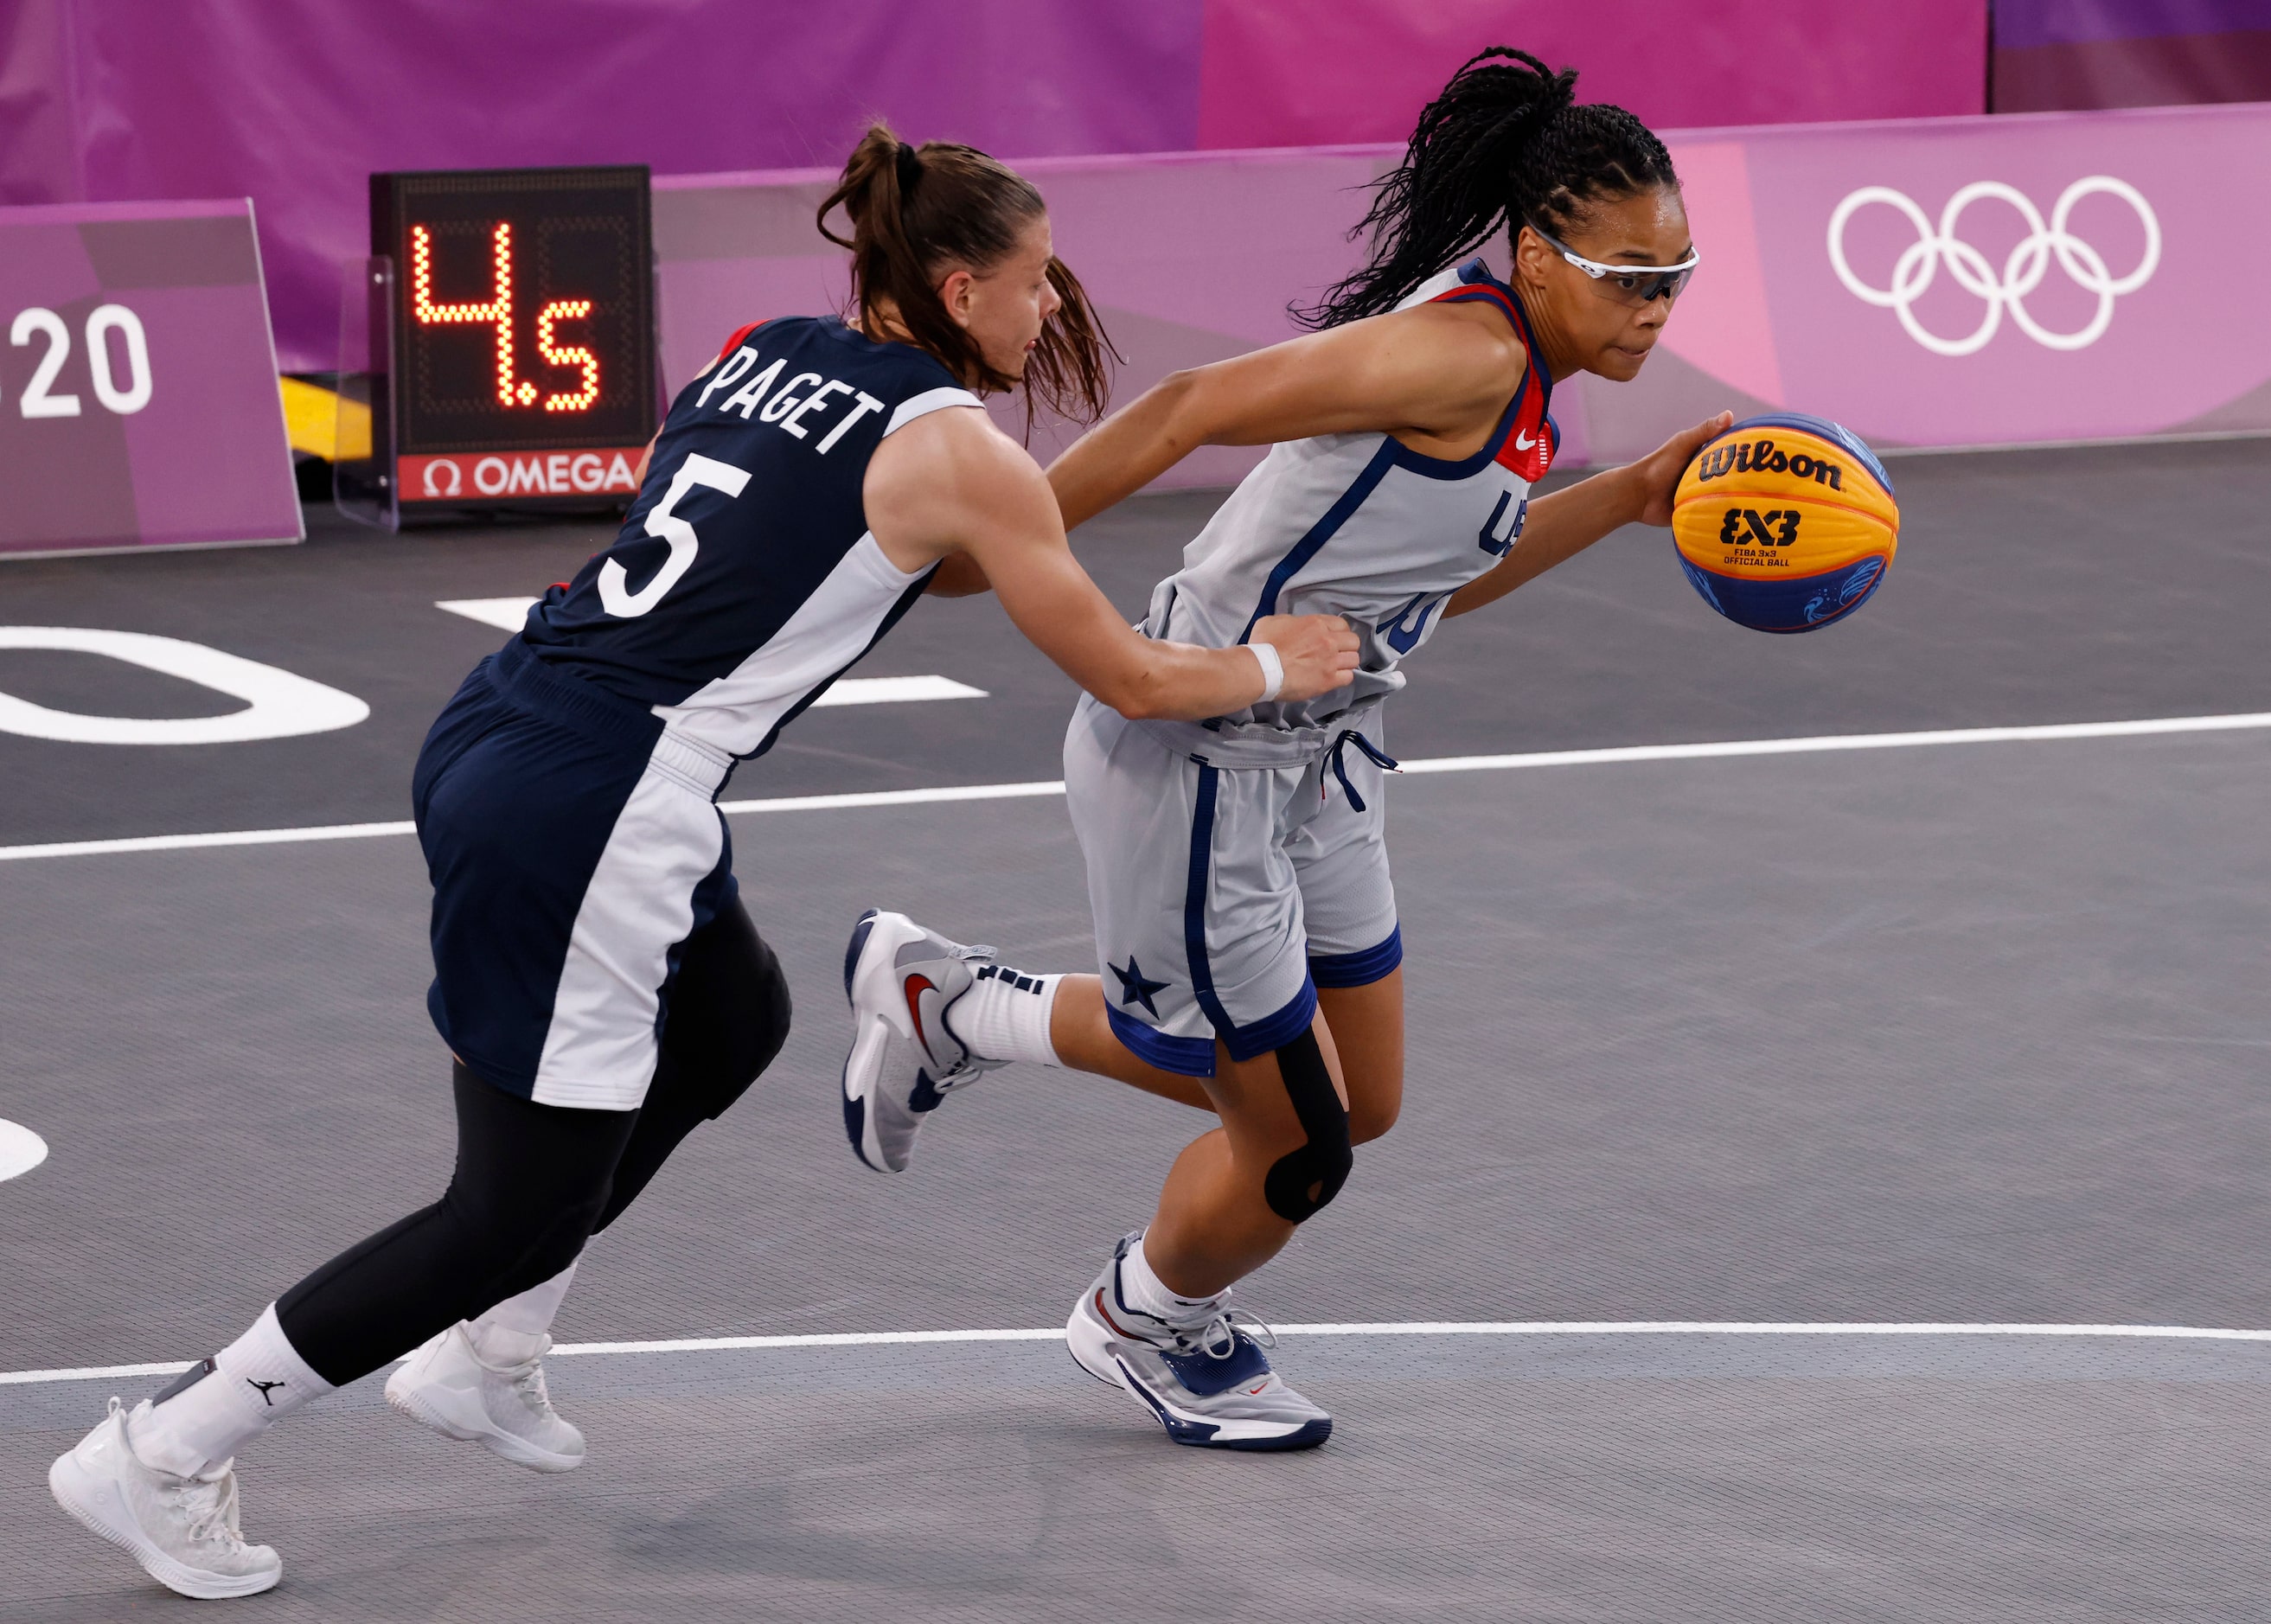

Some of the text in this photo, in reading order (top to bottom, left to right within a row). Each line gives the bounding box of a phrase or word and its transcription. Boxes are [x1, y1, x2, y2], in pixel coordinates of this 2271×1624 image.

[0, 304, 153, 419] 20
[695, 345, 886, 455] PAGET
[474, 452, 637, 496] OMEGA
[1699, 440, 1843, 491] Wilson
[598, 451, 752, 618] 5
[1734, 548, 1756, 557] FIBA
[1724, 556, 1789, 567] OFFICIAL BALL
